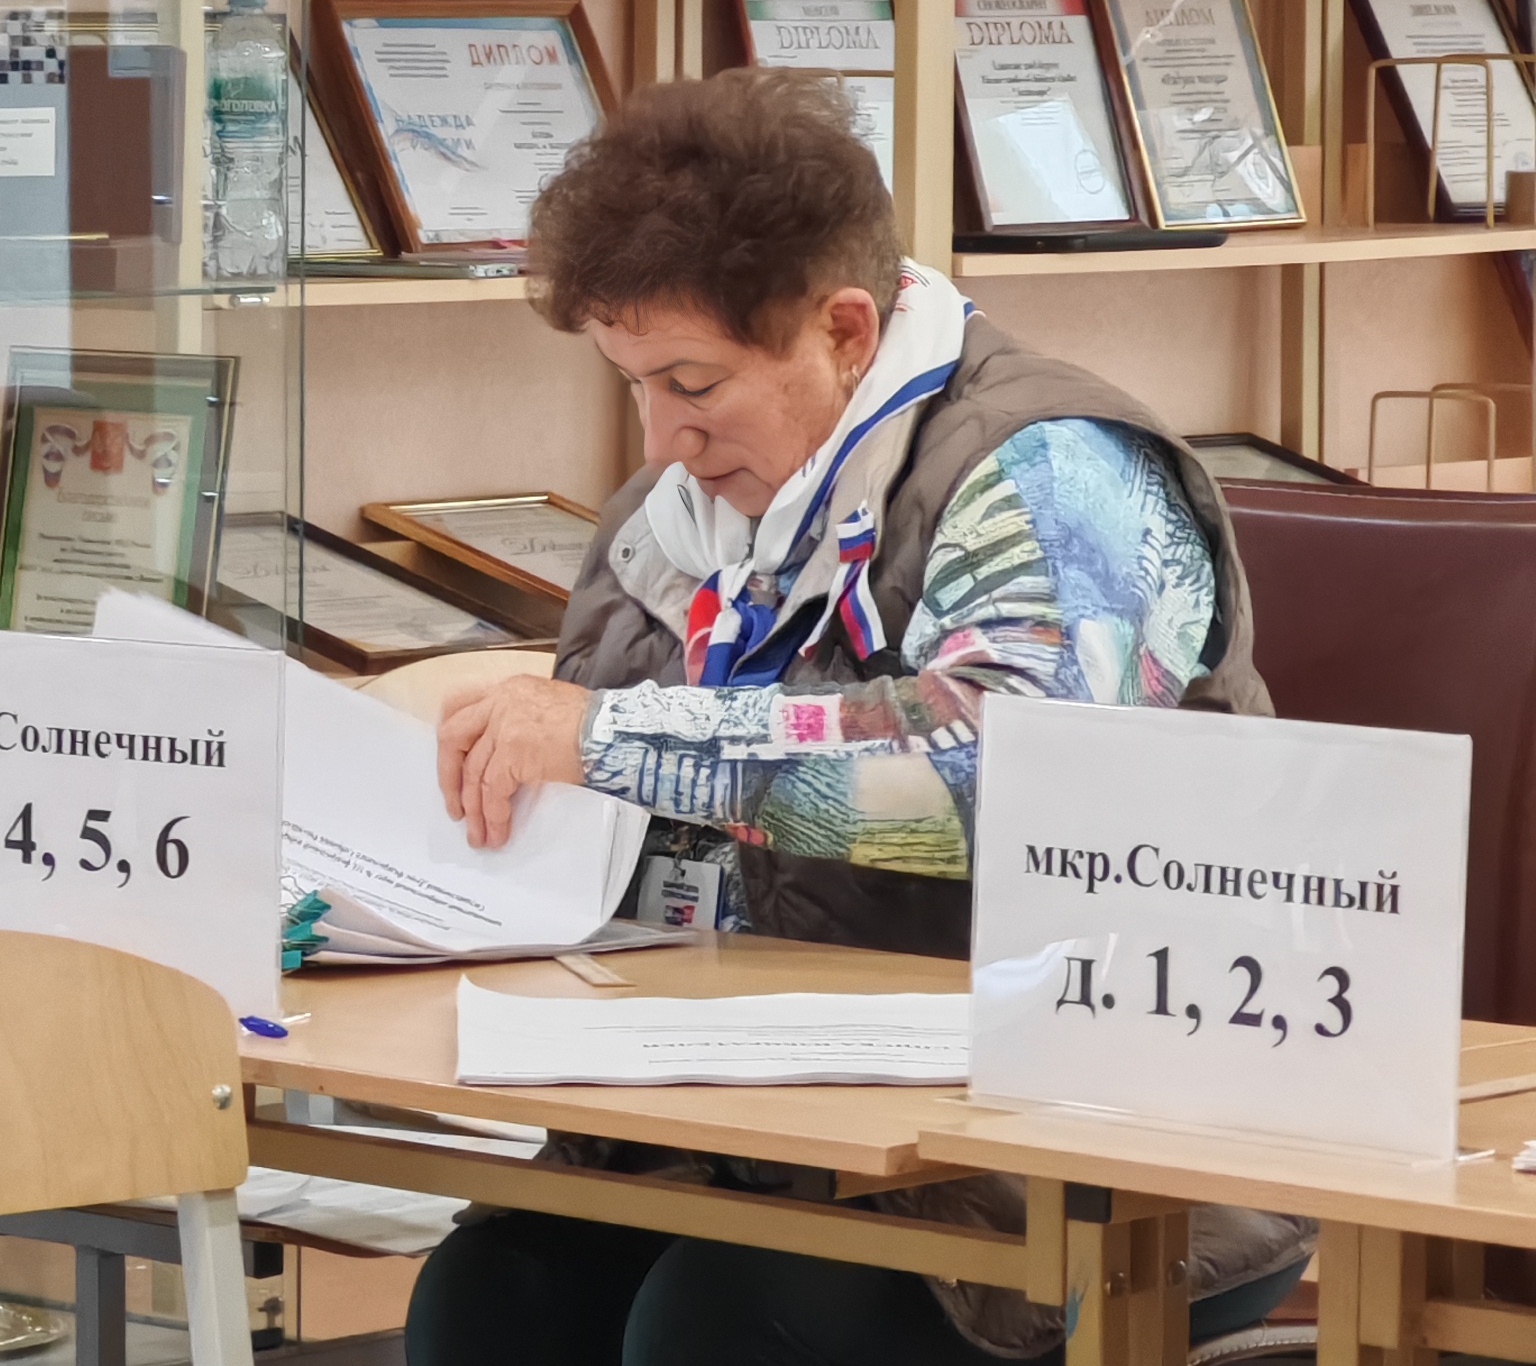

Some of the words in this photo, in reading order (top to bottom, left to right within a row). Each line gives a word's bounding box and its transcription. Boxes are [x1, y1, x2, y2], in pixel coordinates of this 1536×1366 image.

[467, 43, 561, 67] ДИПЛОМ
[775, 25, 881, 51] DIPLOMA
[966, 21, 1074, 46] DIPLOMA
[4, 802, 56, 882] 4,
[78, 809, 132, 889] 5,
[155, 815, 192, 880] 6
[1024, 843, 1402, 916] мкр.Солнечный
[1055, 955, 1116, 1019] д.
[1146, 946, 1202, 1036] 1,
[1228, 955, 1288, 1049] 2,
[1314, 966, 1353, 1038] 3
